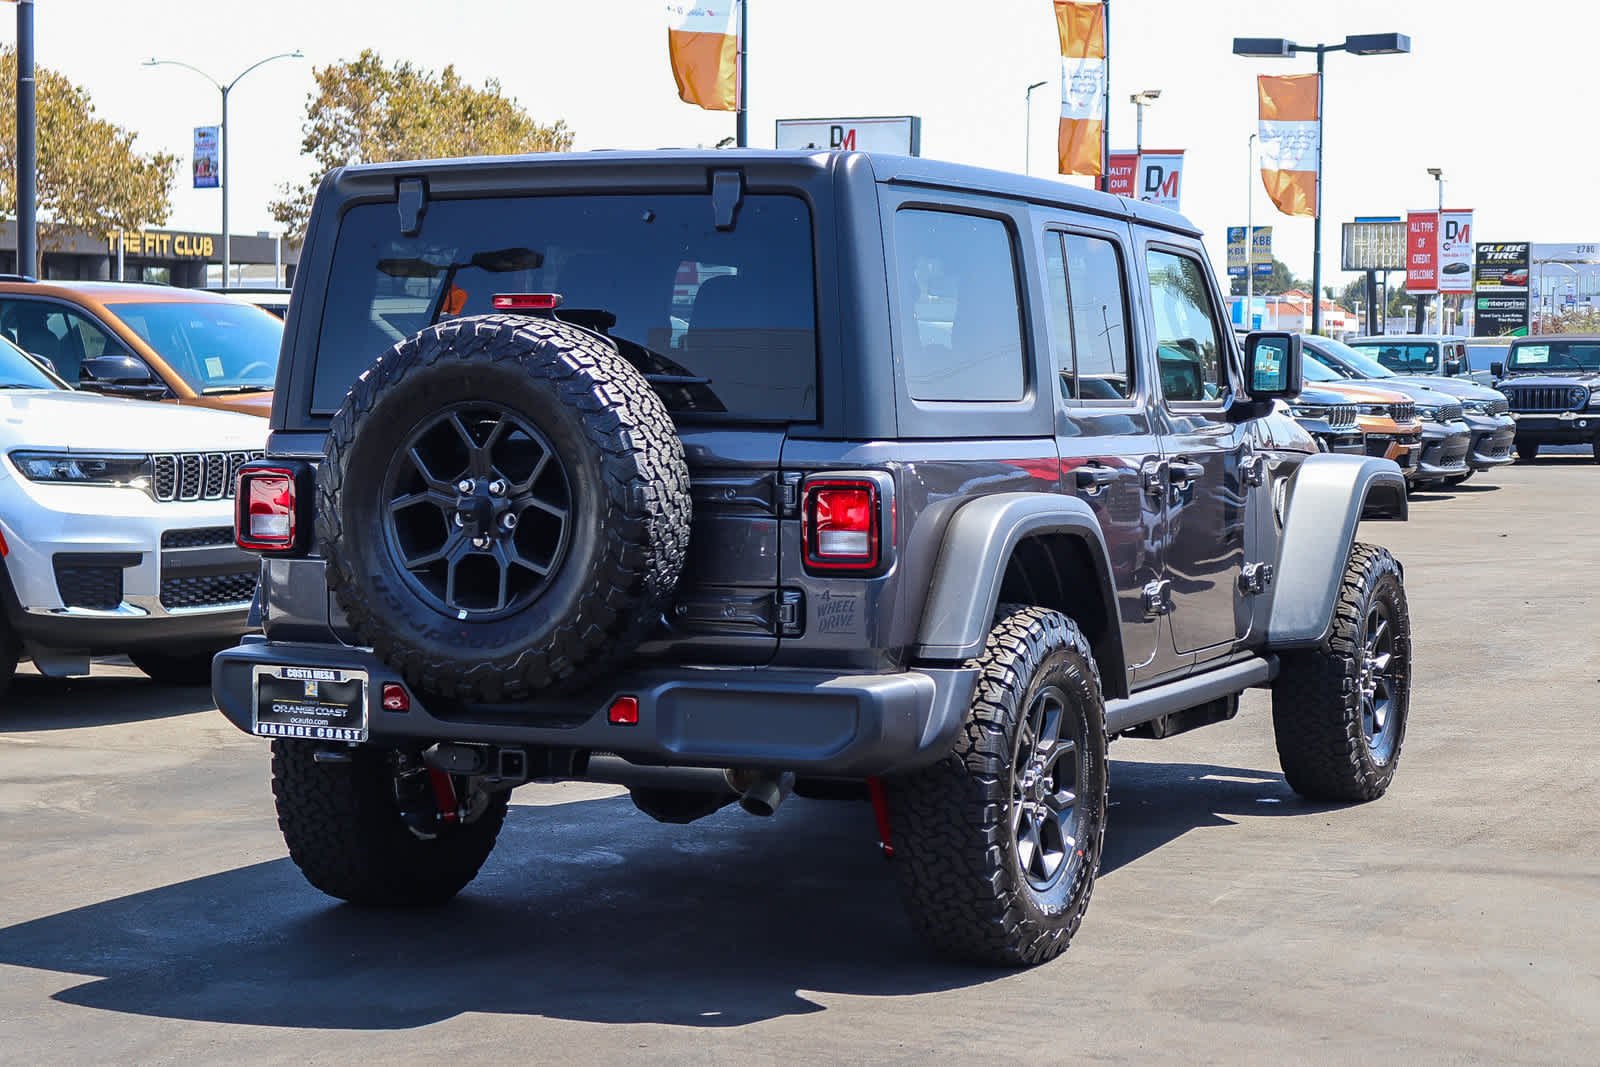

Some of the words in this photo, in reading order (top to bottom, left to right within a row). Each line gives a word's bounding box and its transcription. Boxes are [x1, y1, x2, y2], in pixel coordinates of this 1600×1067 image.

[1111, 179, 1128, 188] OUR
[1411, 222, 1420, 232] ALL
[1421, 222, 1434, 232] TYPE
[106, 231, 141, 253] THE
[145, 232, 171, 255] FIT
[174, 235, 214, 257] CLUB
[1252, 236, 1271, 246] KBB
[1418, 238, 1426, 248] OF
[1412, 254, 1431, 264] CREDIT
[1409, 270, 1434, 280] WELCOME
[1480, 300, 1526, 308] enterprise
[817, 600, 856, 616] WHEEL
[817, 614, 854, 632] DRIVE
[287, 669, 312, 679] COSTA
[313, 670, 335, 680] MESA
[272, 704, 315, 715] ORANGE
[315, 707, 348, 718] COAST
[290, 717, 329, 726] ocauto.com
[261, 725, 312, 736] ORANGE
[317, 728, 360, 740] COAST
